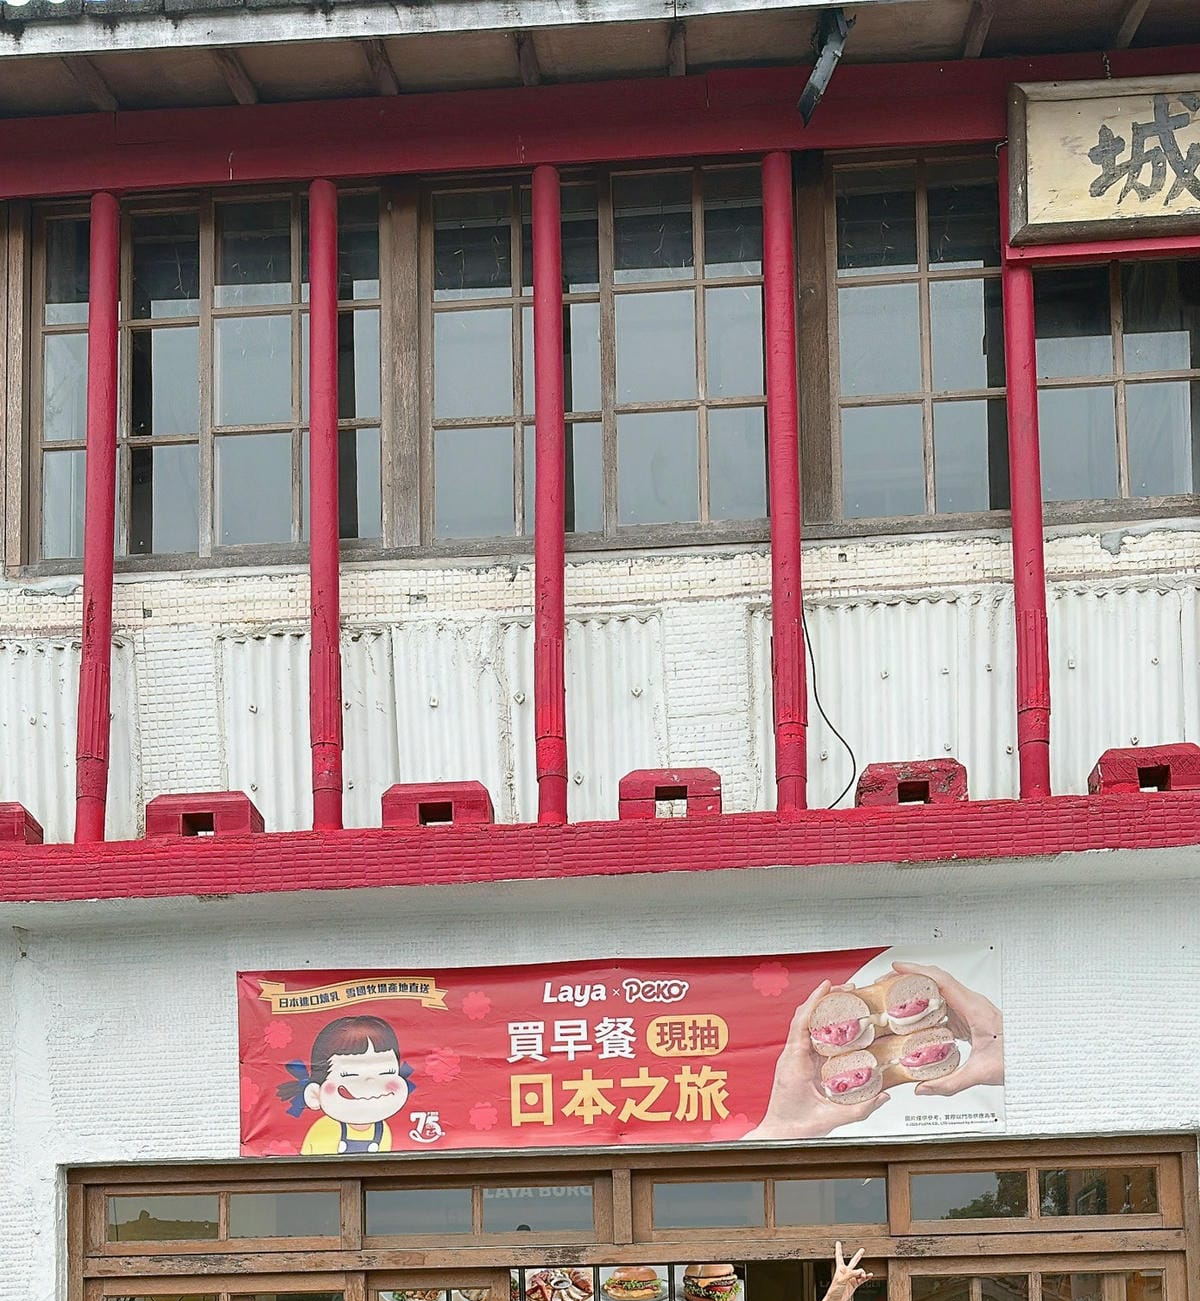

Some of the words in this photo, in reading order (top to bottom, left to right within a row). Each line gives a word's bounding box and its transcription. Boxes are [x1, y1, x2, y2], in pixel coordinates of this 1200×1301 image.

[1087, 91, 1200, 207] 城
[543, 982, 607, 1007] Laya
[506, 1016, 638, 1063] 買早餐
[656, 1019, 720, 1052] 現抽
[510, 1065, 730, 1127] 日本之旅
